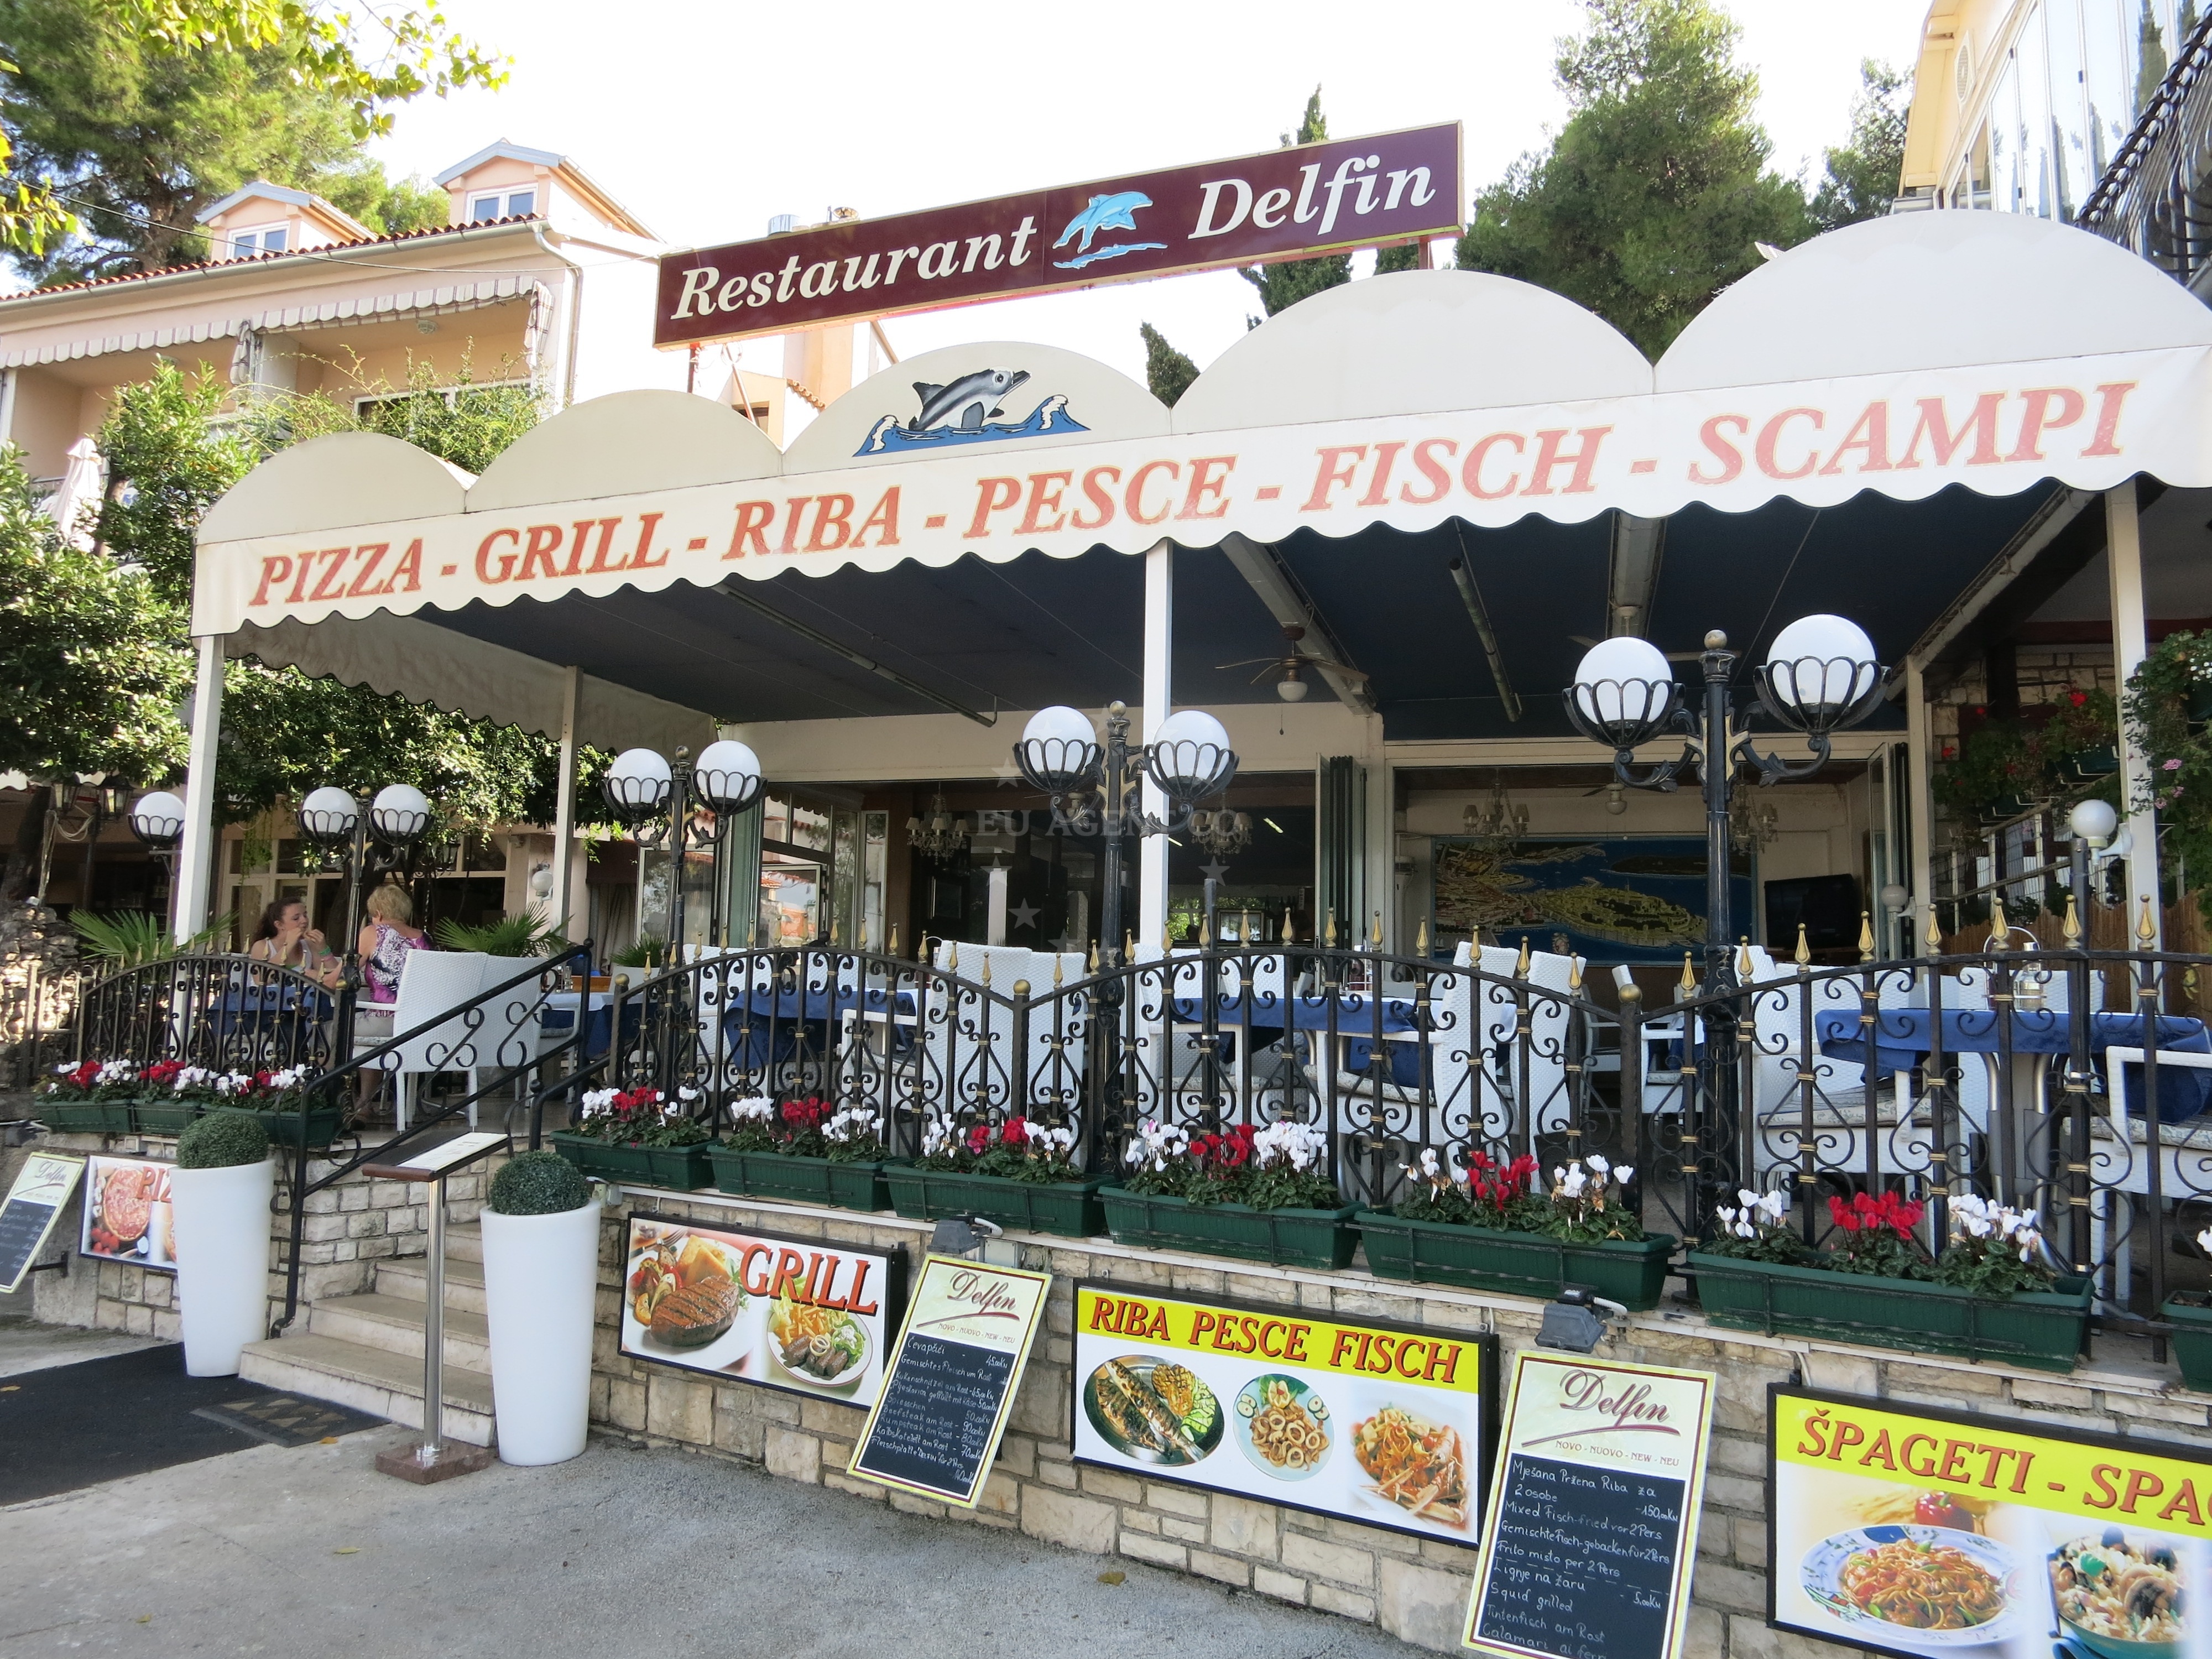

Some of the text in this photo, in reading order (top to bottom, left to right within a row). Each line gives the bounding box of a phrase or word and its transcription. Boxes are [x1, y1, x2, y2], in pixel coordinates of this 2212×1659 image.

[671, 156, 1436, 321] Restaurant Delfin
[247, 536, 422, 607] PIZZA
[474, 513, 670, 585] GRILL
[722, 485, 904, 561] RIBA
[962, 453, 1238, 540] PESCE
[1298, 424, 1615, 514] FISCH
[1686, 380, 2139, 486] SCAMPI
[739, 1243, 879, 1317] GRILL
[947, 1270, 1018, 1313] Delfin
[938, 1323, 956, 1332] NOVO
[959, 1327, 981, 1337] NUOVO
[985, 1332, 999, 1340] NEW
[1003, 1335, 1016, 1344] NEU
[1089, 1297, 1463, 1384] RIBA PESCE FISCH
[1559, 1369, 1670, 1427] Delfin
[1556, 1440, 1582, 1451] NOVO
[1589, 1446, 1623, 1458] NUOVO
[1631, 1452, 1652, 1463] NEW
[1660, 1456, 1679, 1467] NEU
[1797, 1407, 2036, 1494] ŠPAGETI
[2083, 1463, 2212, 1526] SPA
[1512, 1459, 1556, 1480] Mješana
[1559, 1468, 1597, 1489] Pržena
[1601, 1475, 1628, 1493] Riba
[1514, 1484, 1558, 1503] 2 osobe
[1501, 1520, 1554, 1542] Gemischte
[1504, 1500, 1540, 1517] Mixed
[1629, 1523, 1637, 1536] 2
[1497, 1540, 1525, 1556] Frito
[1528, 1550, 1561, 1564] misto
[1564, 1558, 1584, 1571] per
[1588, 1560, 1596, 1573] 2
[1535, 1573, 1551, 1584] na
[1490, 1582, 1573, 1613] Squid grilled
[1482, 1623, 1549, 1650] Calamari
[1554, 1624, 1574, 1637] am
[1576, 1623, 1605, 1643] Rost
